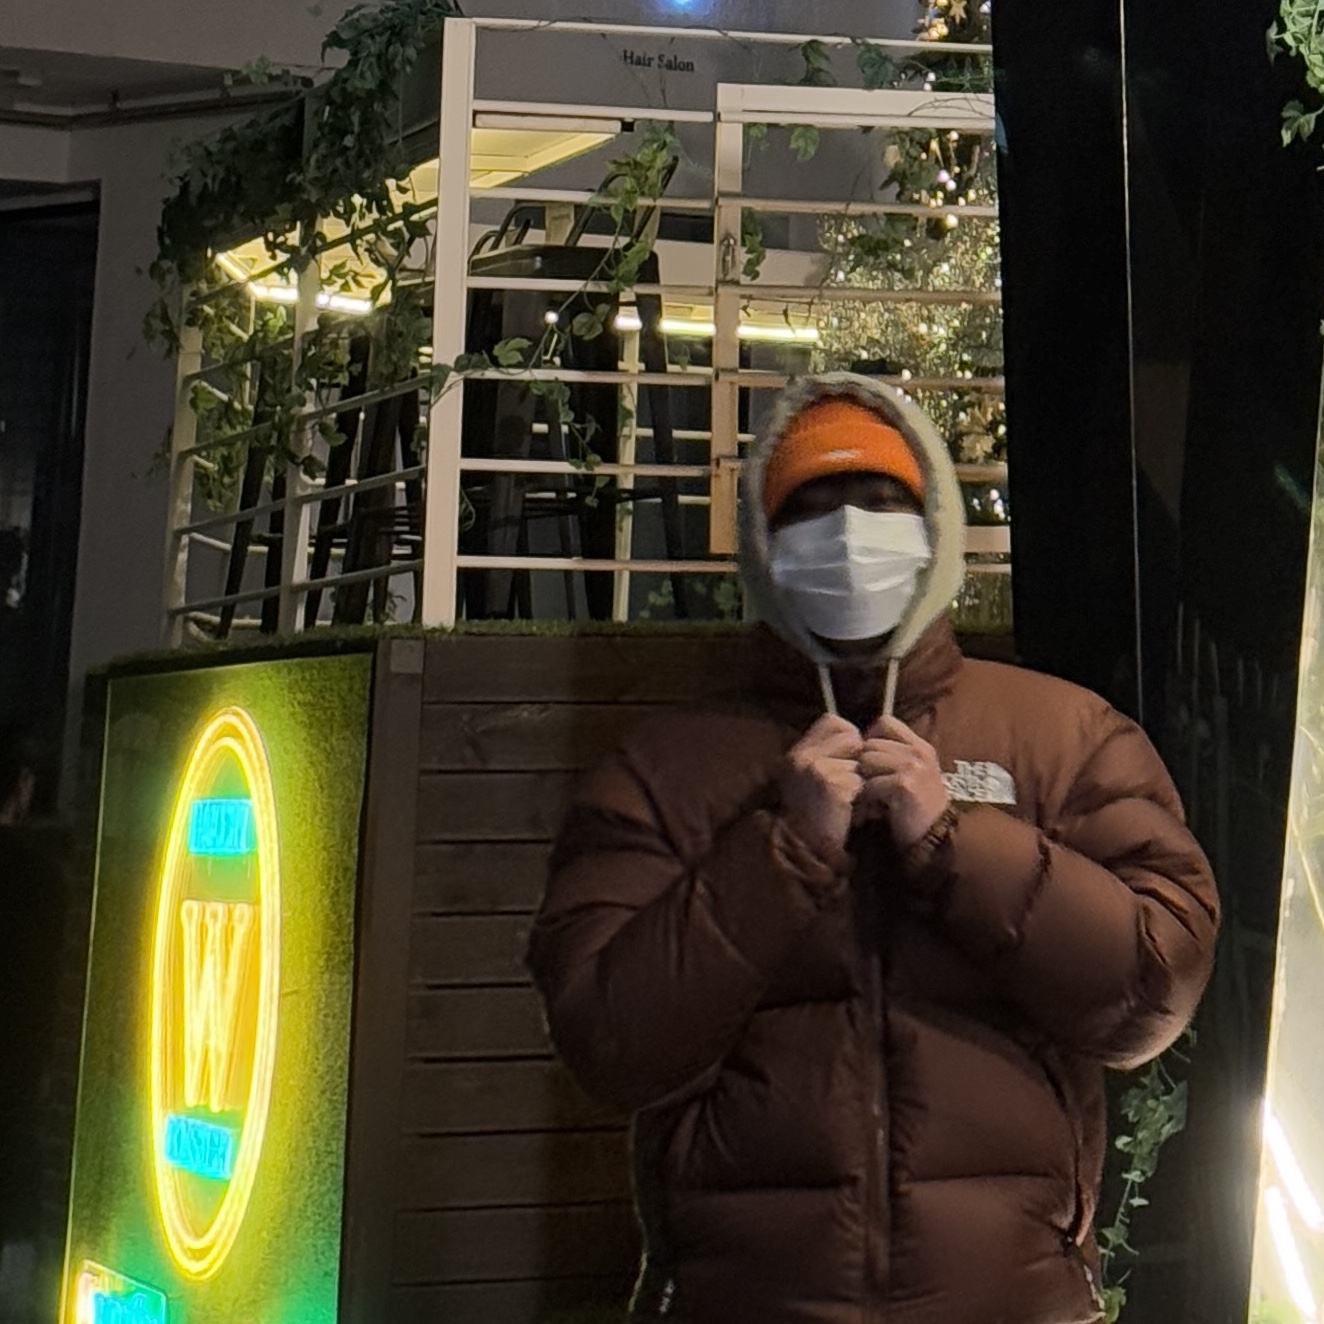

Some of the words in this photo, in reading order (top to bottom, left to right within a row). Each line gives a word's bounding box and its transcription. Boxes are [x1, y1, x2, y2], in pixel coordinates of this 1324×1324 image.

[623, 49, 655, 68] Hair
[658, 53, 695, 73] Salon
[181, 899, 253, 1113] W
